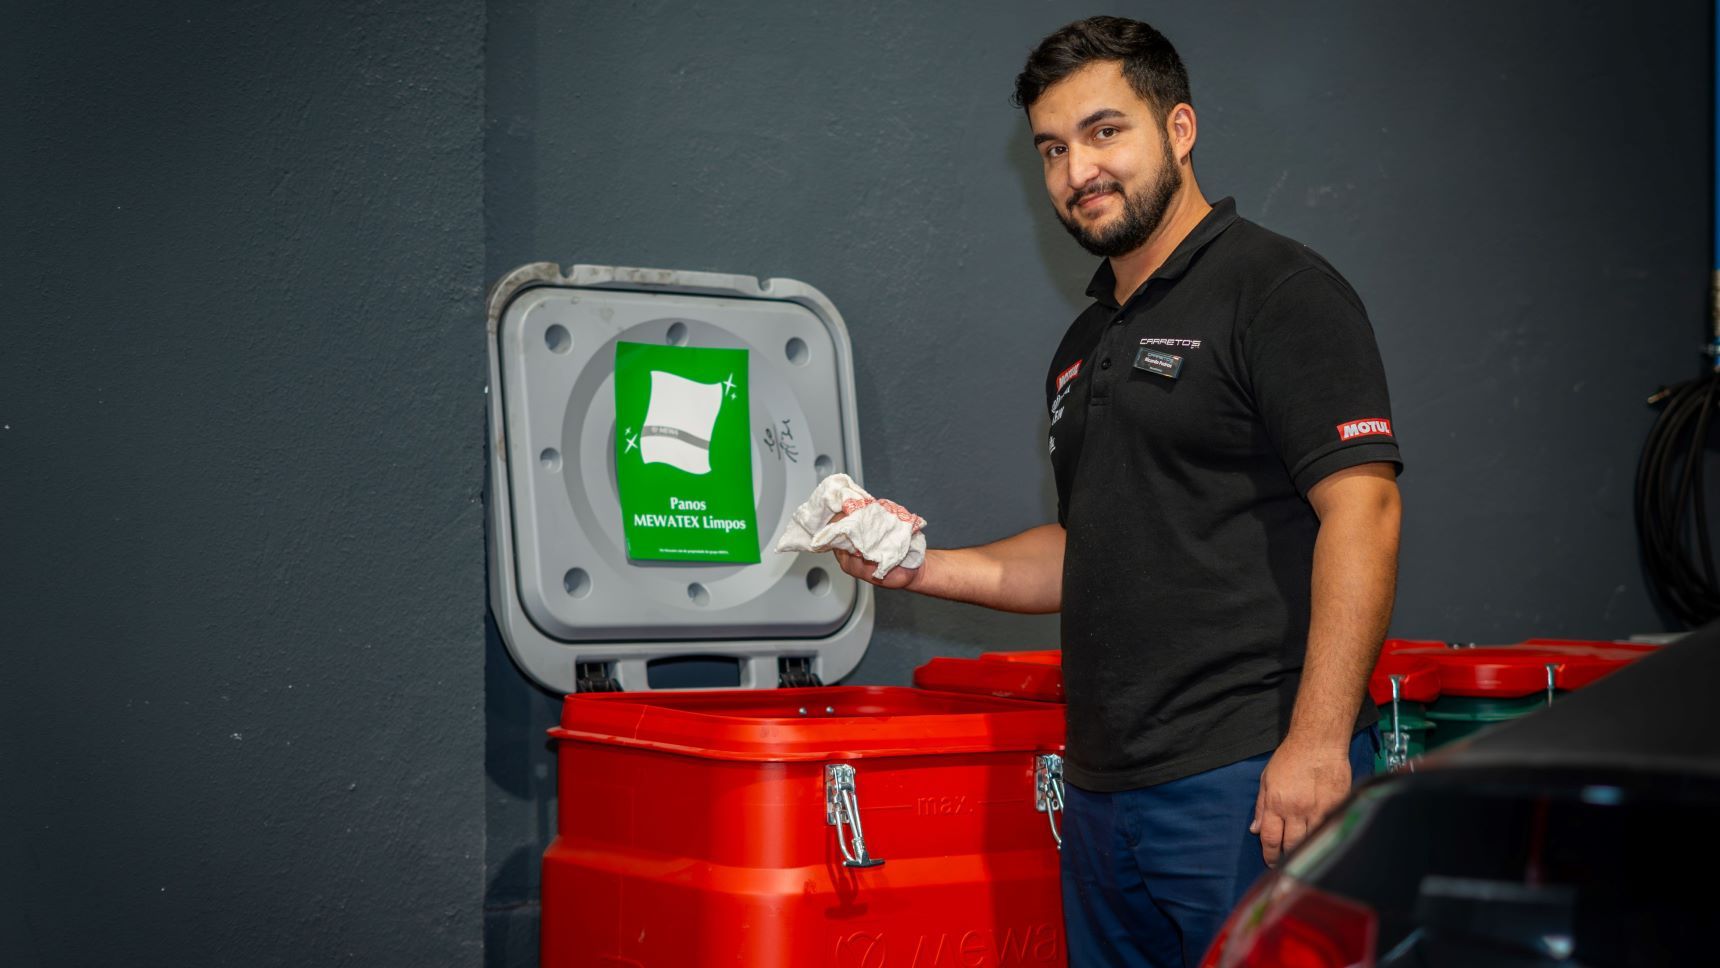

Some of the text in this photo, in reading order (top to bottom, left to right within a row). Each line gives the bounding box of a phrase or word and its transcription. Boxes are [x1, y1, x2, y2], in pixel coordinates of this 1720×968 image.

[1343, 420, 1390, 438] MOTUL
[670, 496, 707, 510] Panos
[634, 514, 746, 533] MEWATEX Limpos
[917, 795, 974, 816] max.
